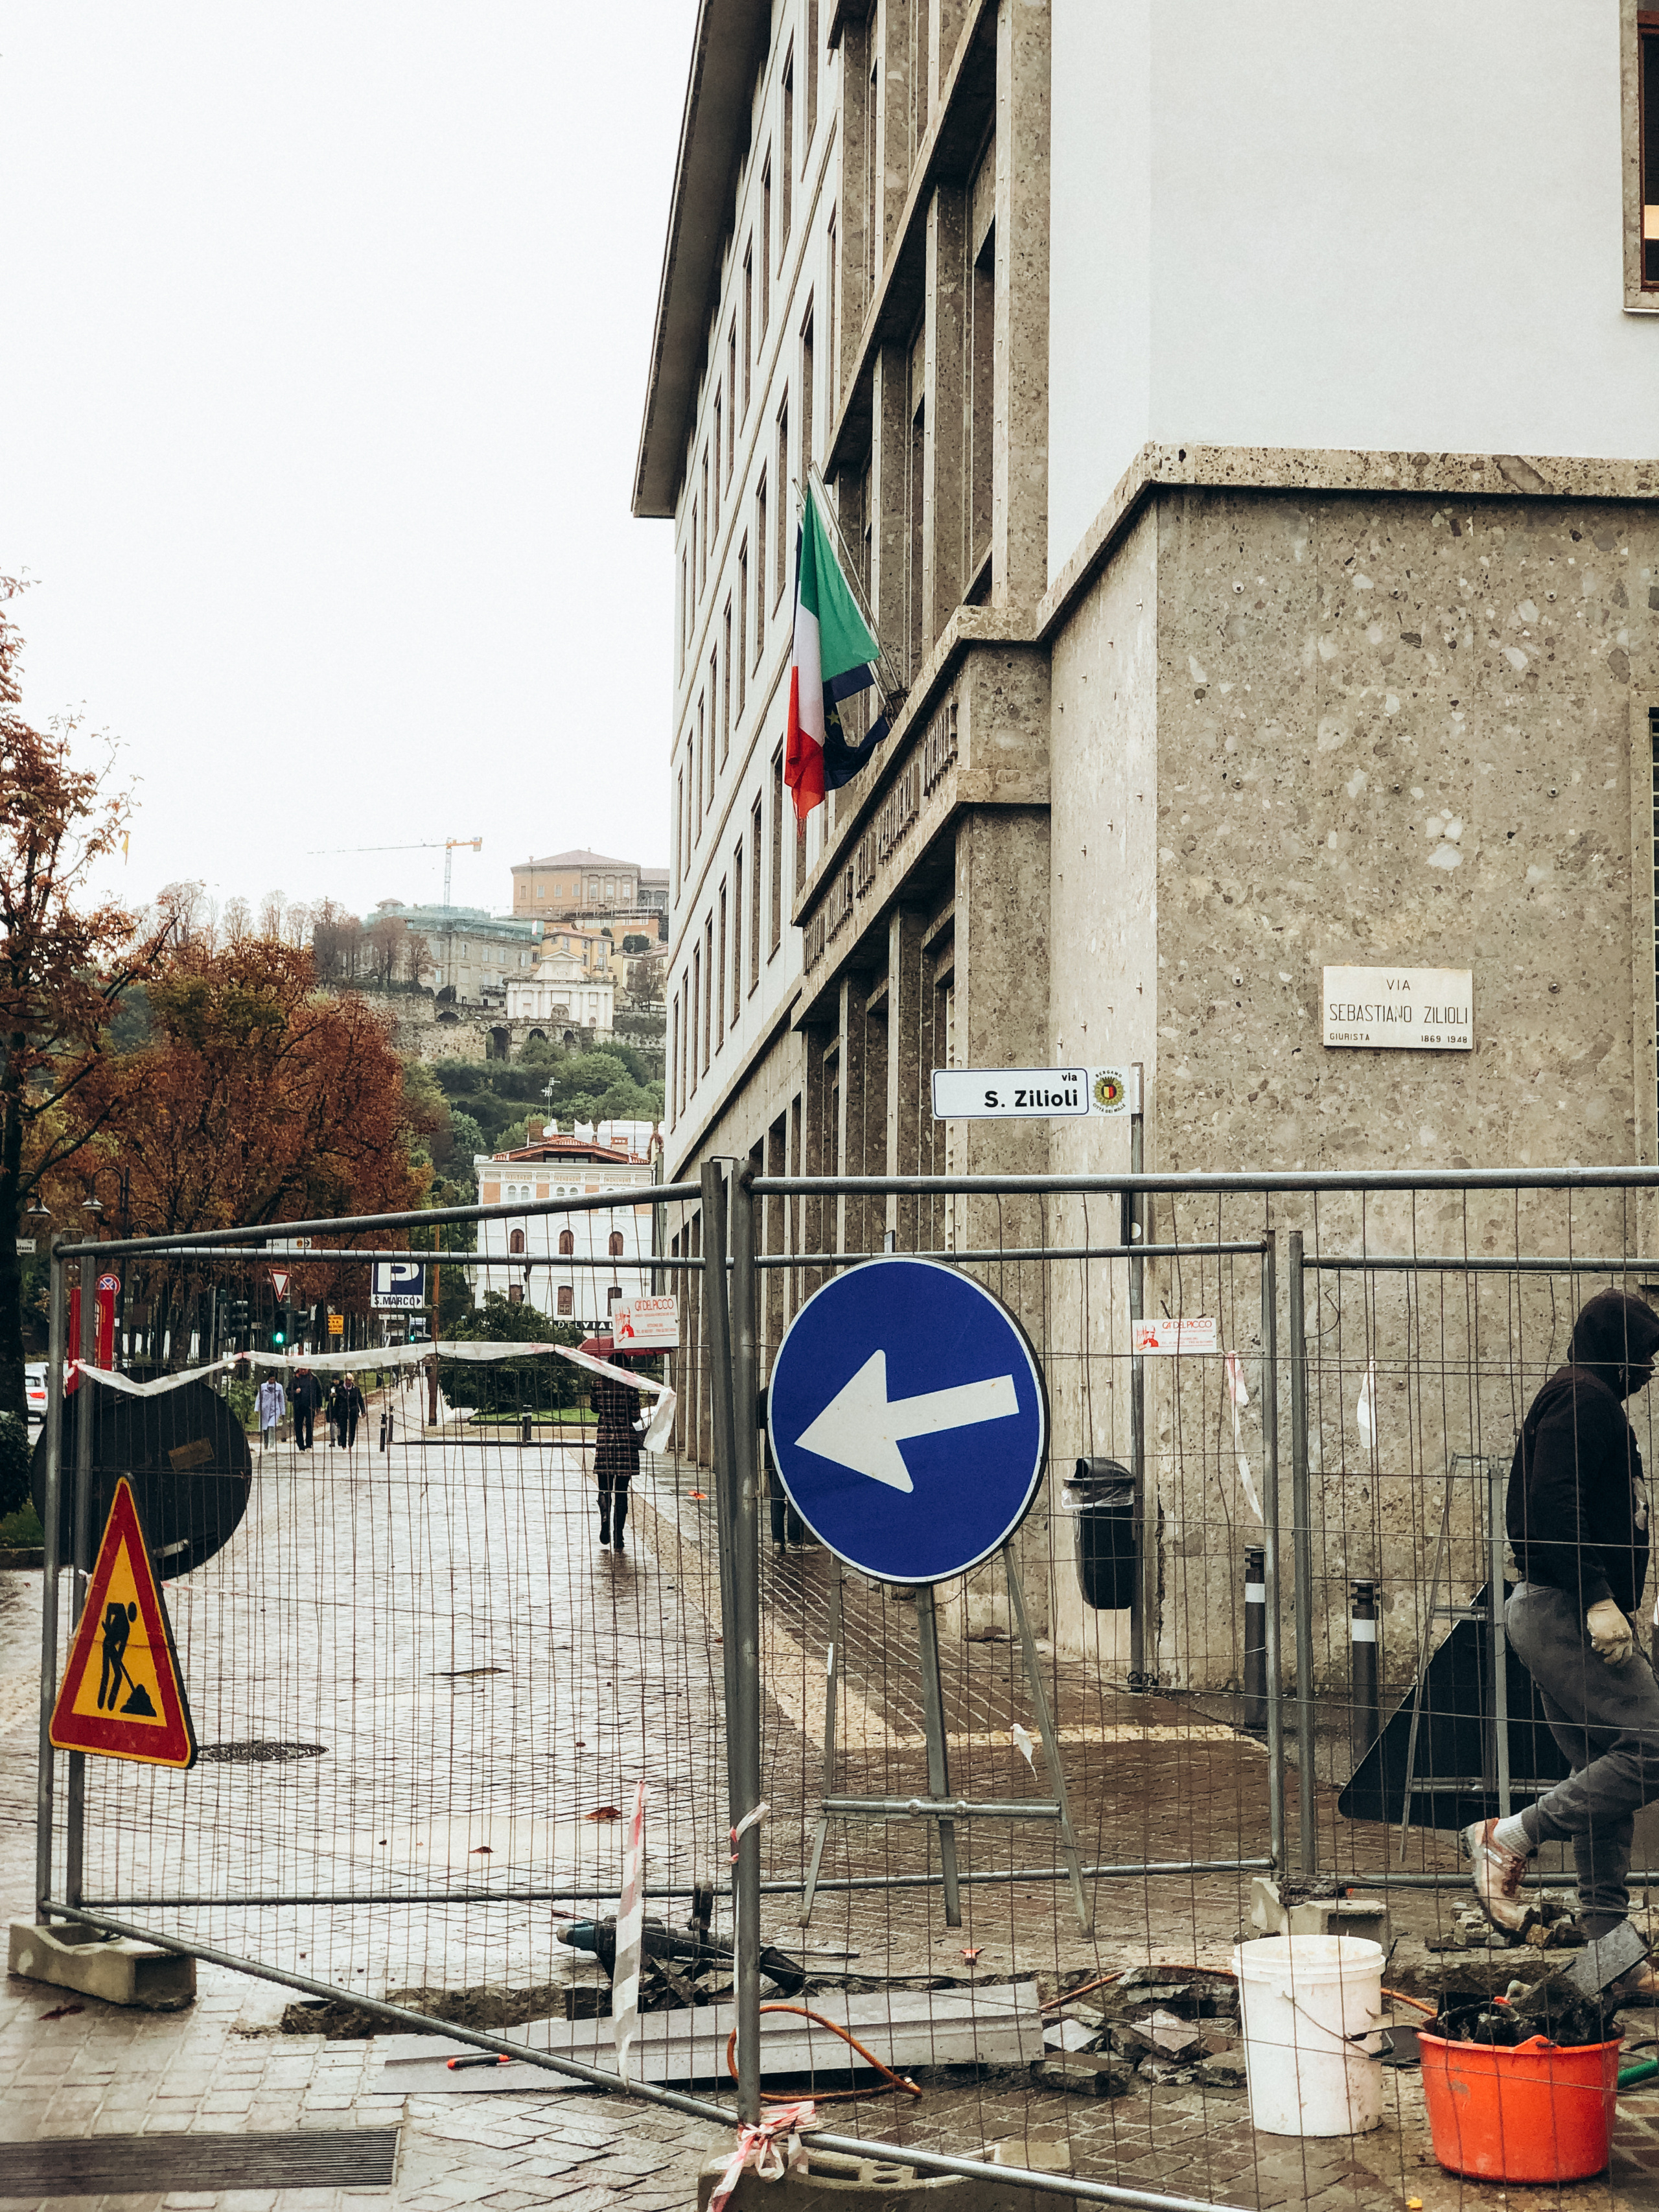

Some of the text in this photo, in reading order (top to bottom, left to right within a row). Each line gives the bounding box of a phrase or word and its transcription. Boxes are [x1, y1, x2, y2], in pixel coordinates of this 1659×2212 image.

[1386, 979, 1411, 991] VIA
[1329, 1004, 1468, 1024] SEBASTIANO ZILIOLI
[1062, 1073, 1078, 1081] via
[1095, 1069, 1122, 1078] BERGAMO
[984, 1089, 1078, 1108] S. Zilioli
[1114, 1103, 1126, 1112] MILLE
[642, 1299, 653, 1310] DEL
[653, 1298, 674, 1310] PICCO
